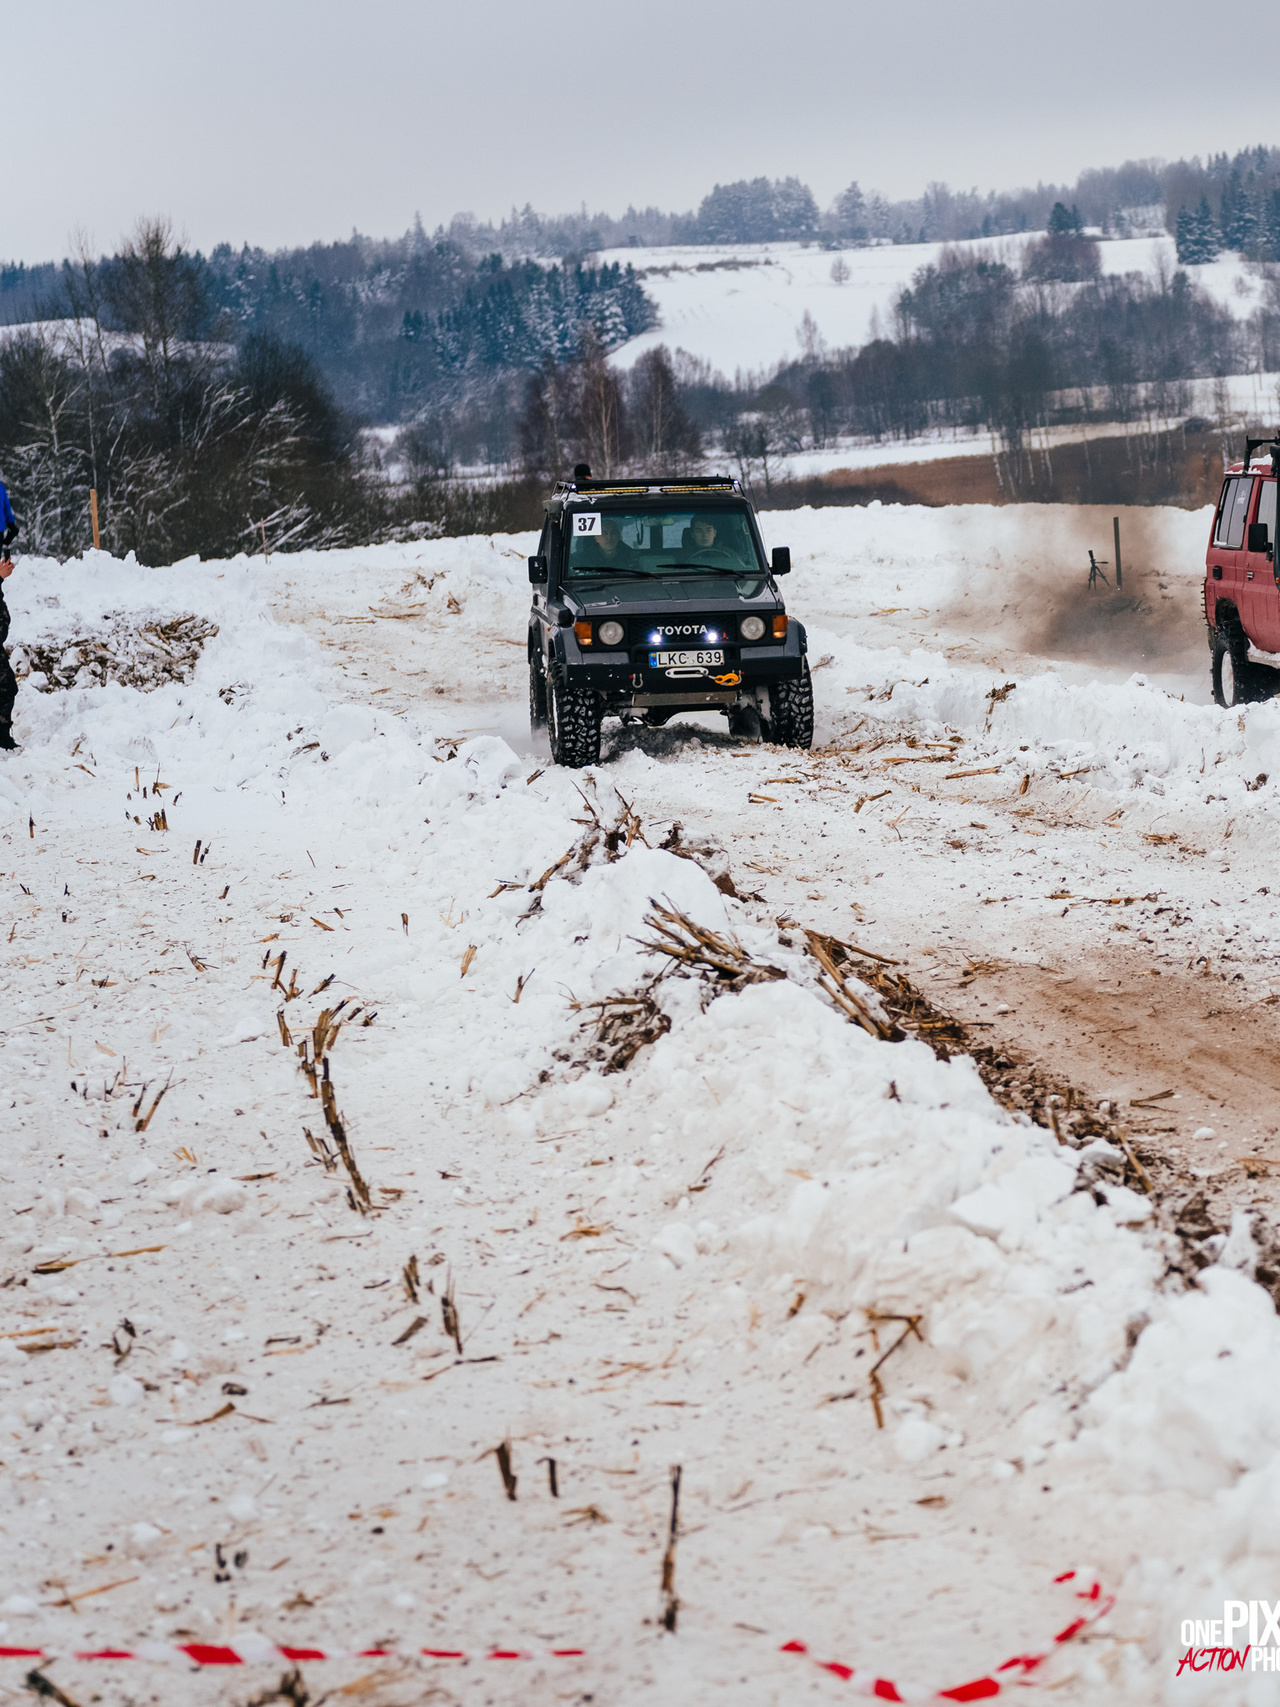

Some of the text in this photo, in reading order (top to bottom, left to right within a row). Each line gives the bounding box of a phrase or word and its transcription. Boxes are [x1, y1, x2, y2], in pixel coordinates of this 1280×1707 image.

[578, 517, 596, 532] 37
[656, 625, 708, 635] TOYOTA
[658, 653, 687, 665] LKC
[696, 651, 721, 664] 639
